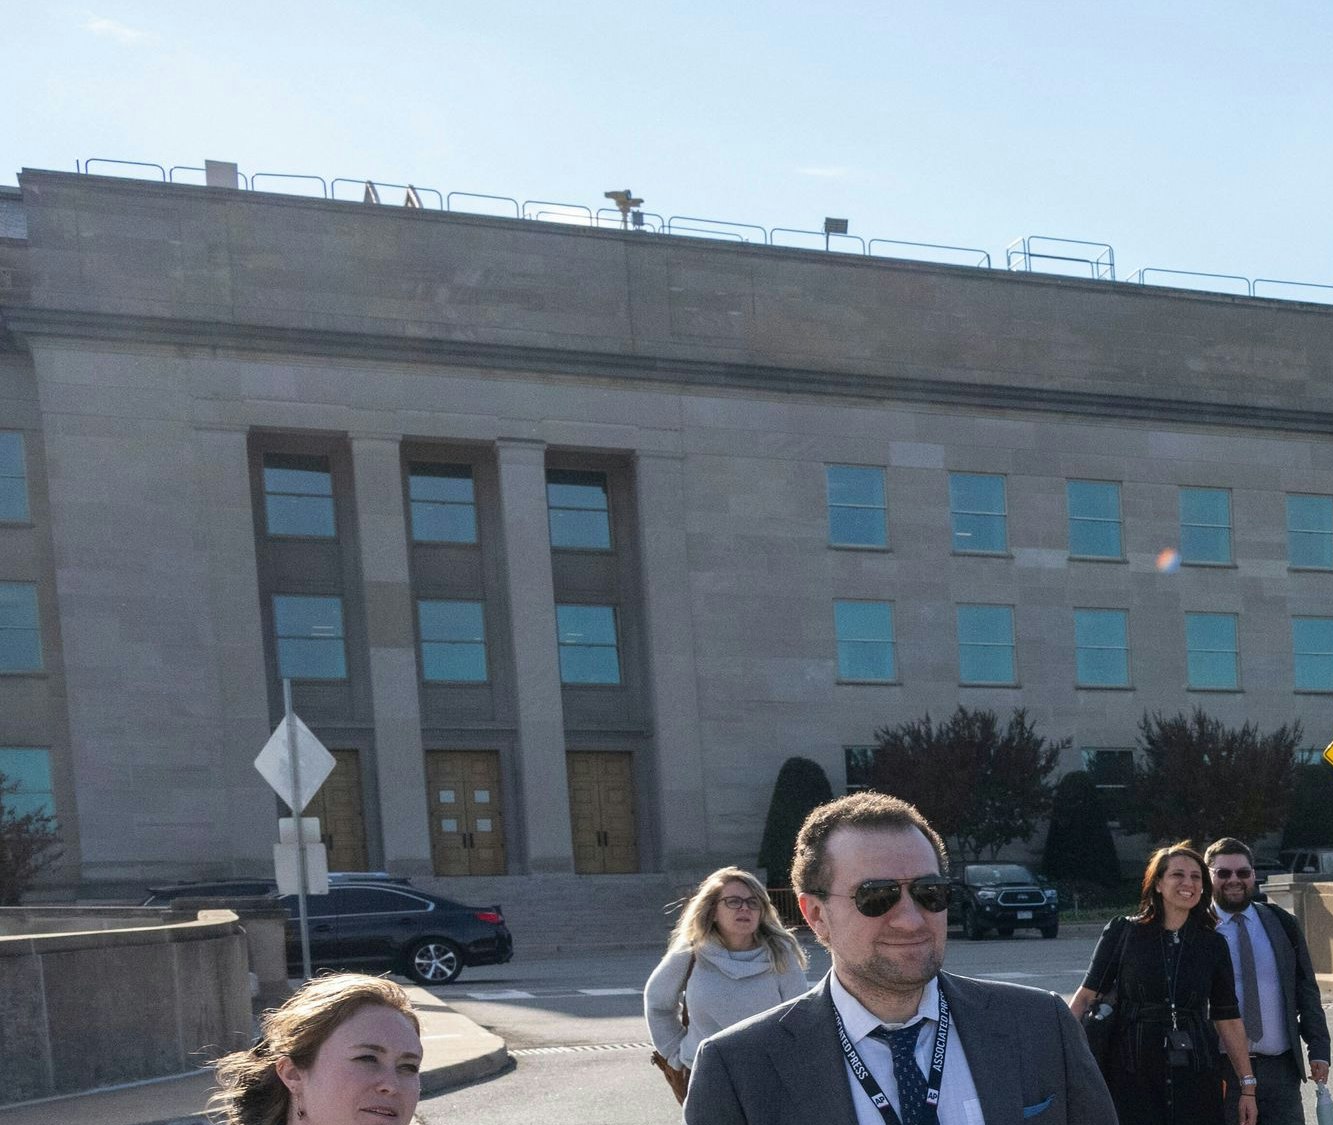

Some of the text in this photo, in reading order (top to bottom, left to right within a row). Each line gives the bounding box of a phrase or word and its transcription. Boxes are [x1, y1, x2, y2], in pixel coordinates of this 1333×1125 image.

[932, 1015, 949, 1072] ASSOCIATED
[847, 1051, 869, 1080] PRESS
[874, 1096, 885, 1105] AP
[927, 1092, 938, 1100] AP
